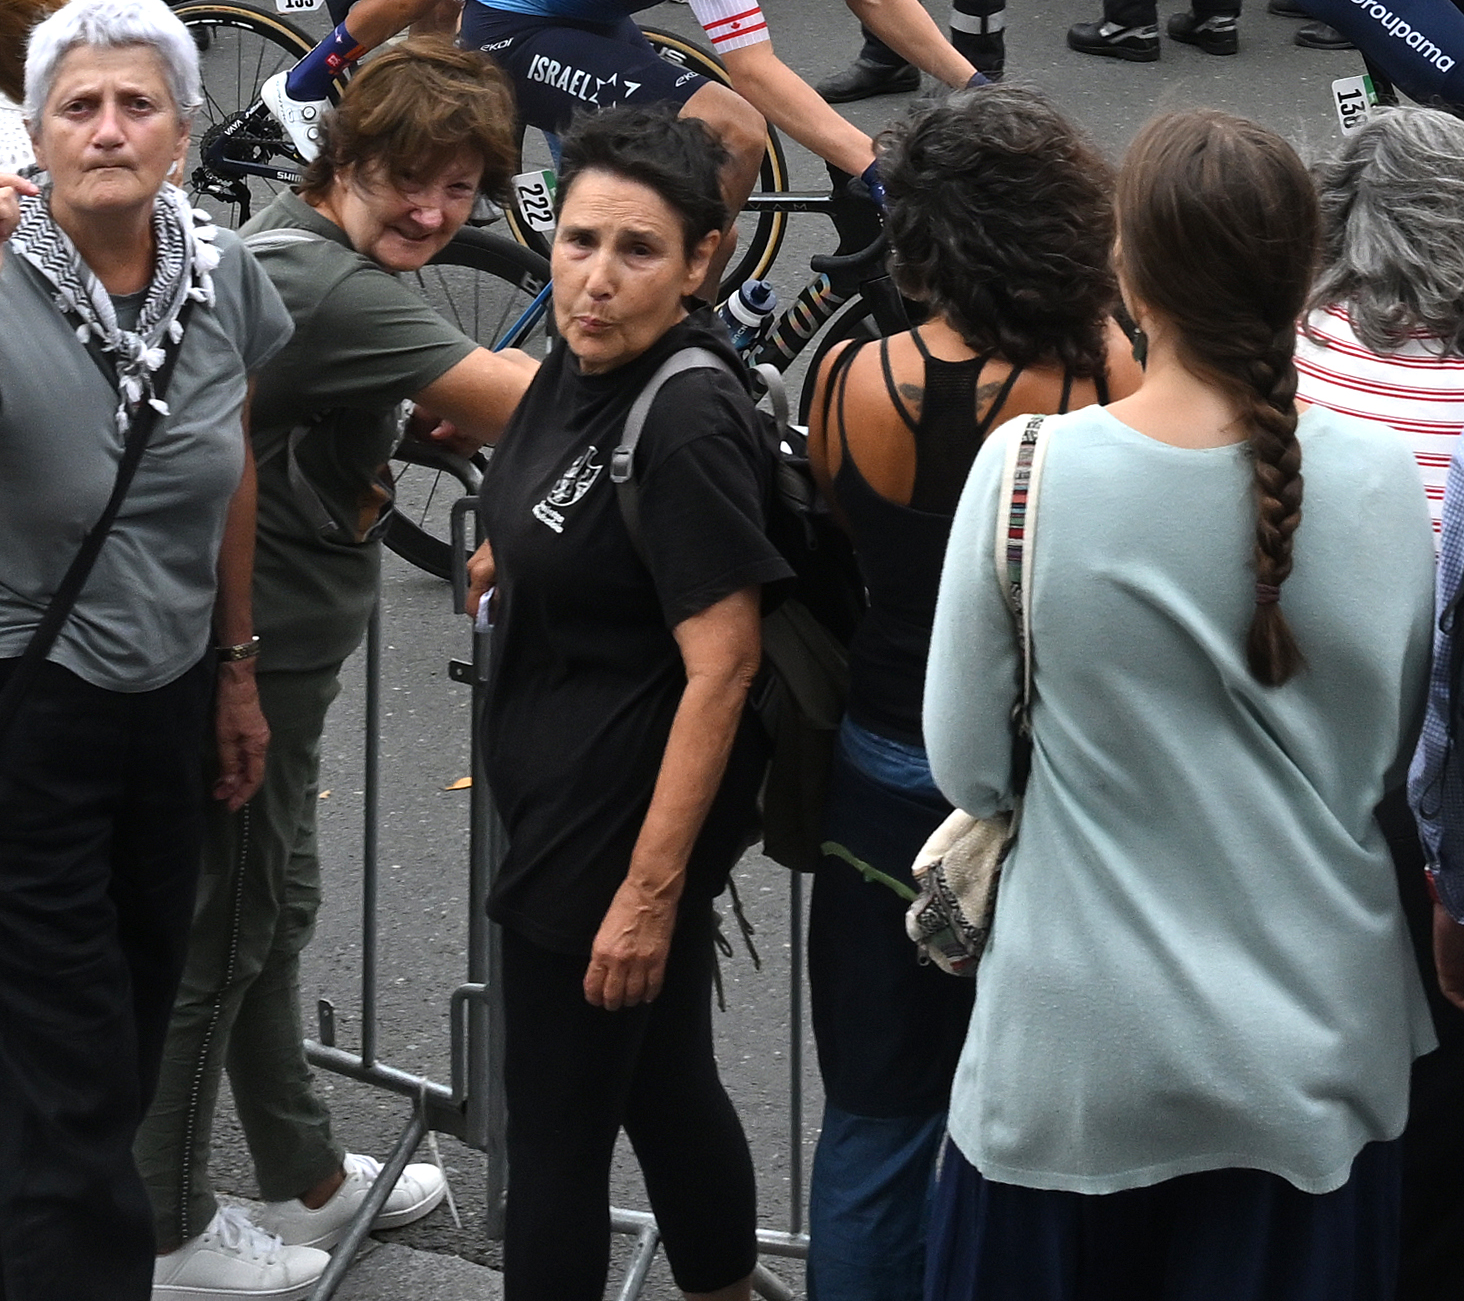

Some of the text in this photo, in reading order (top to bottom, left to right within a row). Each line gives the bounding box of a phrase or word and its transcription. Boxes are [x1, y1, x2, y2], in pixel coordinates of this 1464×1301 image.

[527, 52, 591, 100] ISRAEL
[276, 170, 305, 182] SHIM
[517, 183, 554, 226] 222
